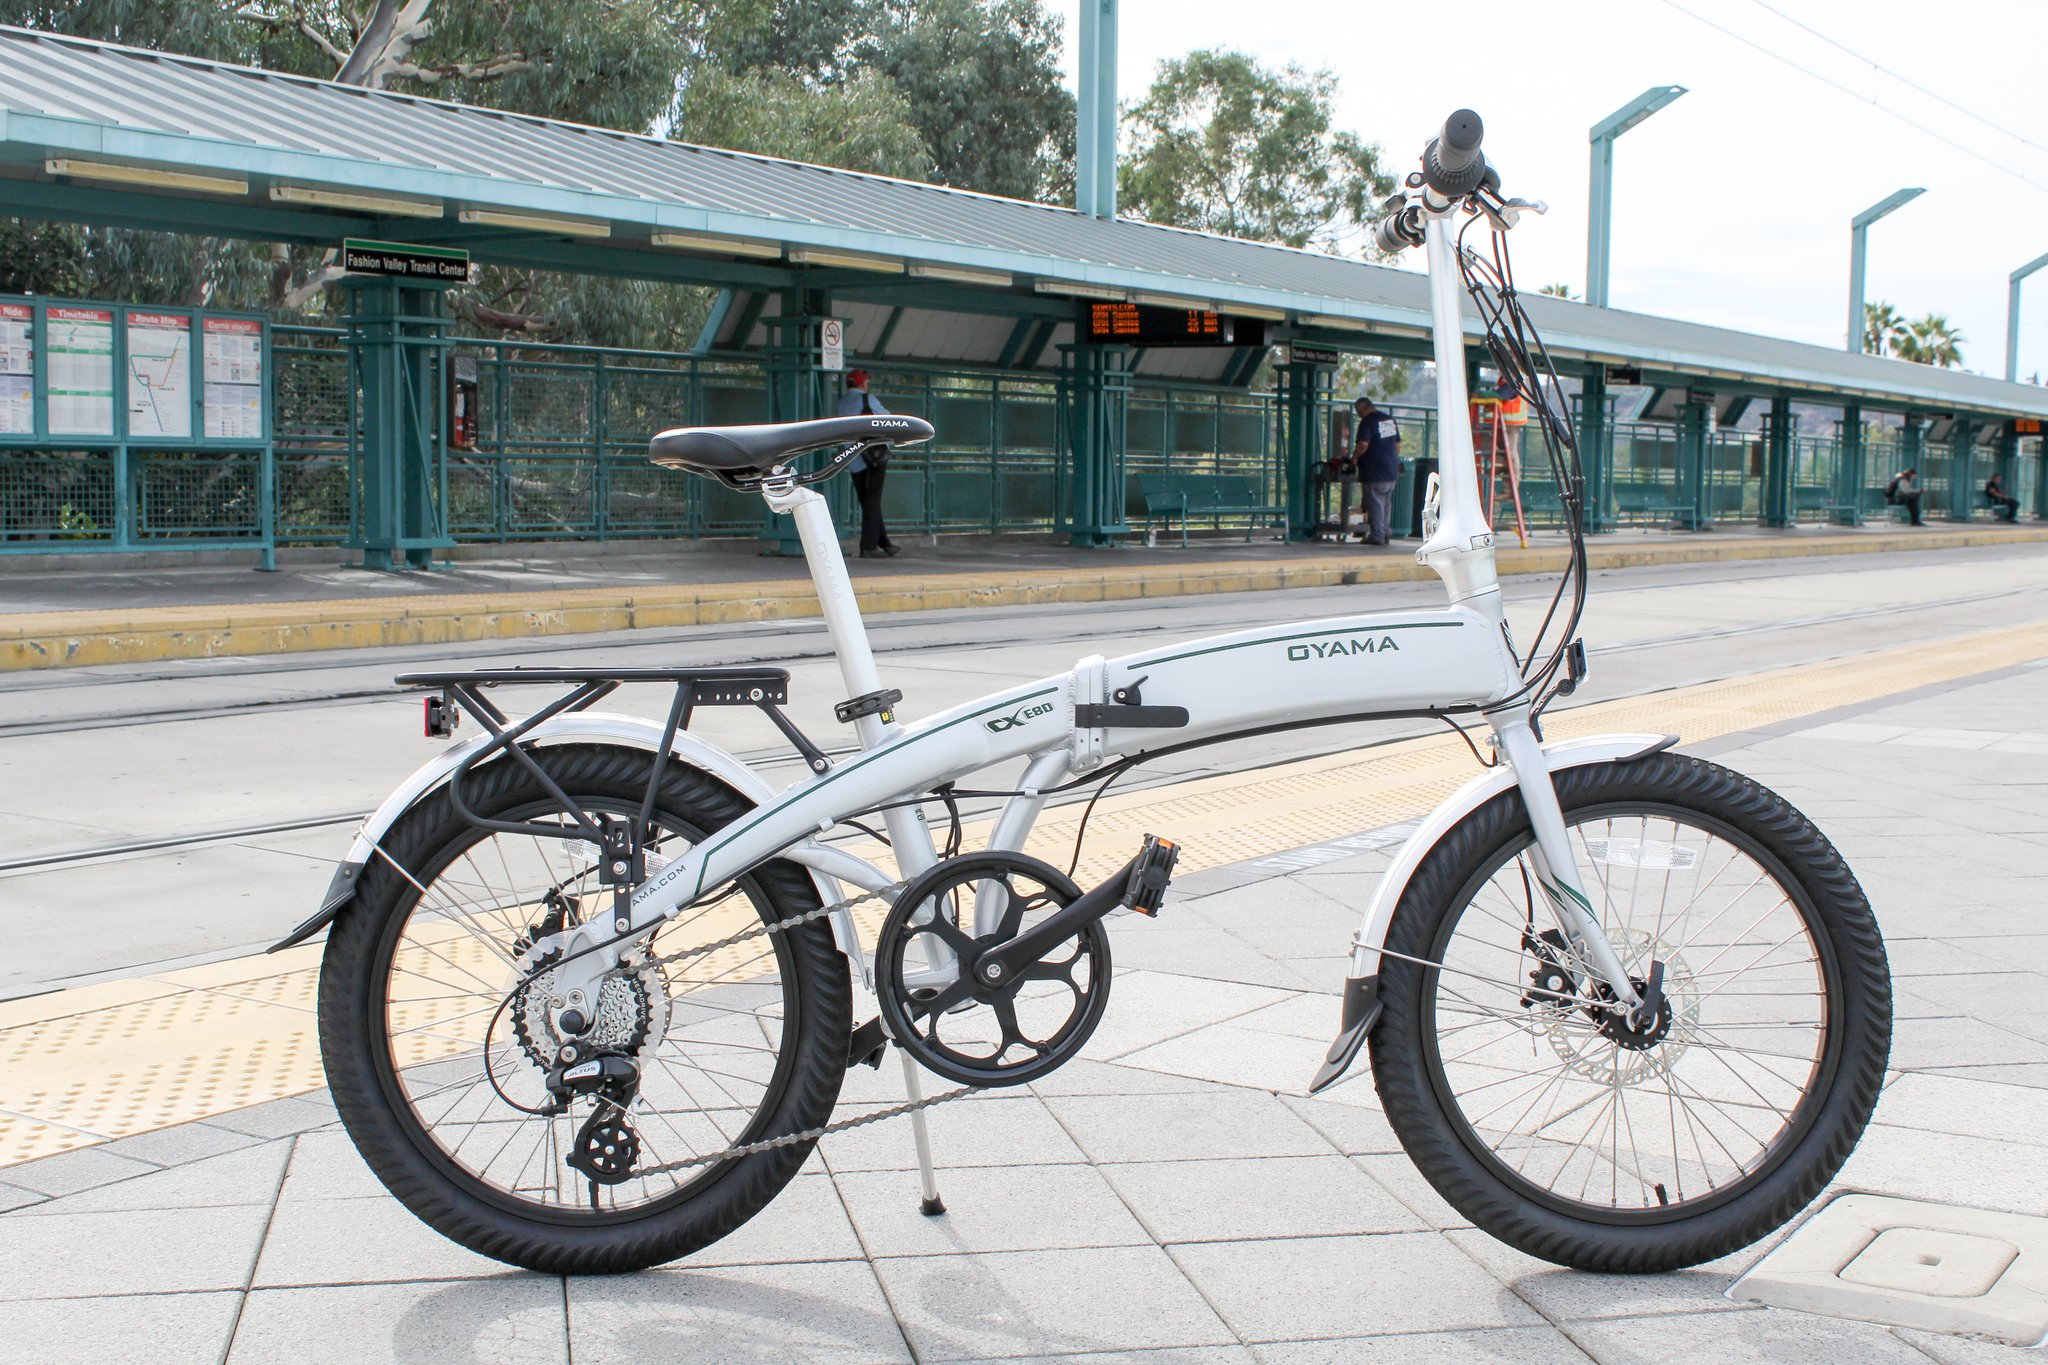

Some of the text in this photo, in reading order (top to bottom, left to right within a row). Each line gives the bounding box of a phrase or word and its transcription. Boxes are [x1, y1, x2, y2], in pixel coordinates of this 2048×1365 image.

[348, 253, 465, 276] Fashion Valley Transit Center
[3, 306, 22, 317] Ride
[58, 309, 98, 320] Timetable
[1112, 311, 1139, 319] Santee
[135, 313, 177, 326] Route Map
[208, 321, 230, 329] Como
[1113, 319, 1139, 327] Santee
[1187, 318, 1199, 326] 25
[871, 420, 909, 428] OYAMA
[834, 441, 865, 463] OYAMA
[1287, 635, 1400, 662] OYAMA
[984, 705, 1028, 733] CX
[632, 864, 687, 907] AMA.COM
[568, 1066, 596, 1077] ALTUS
